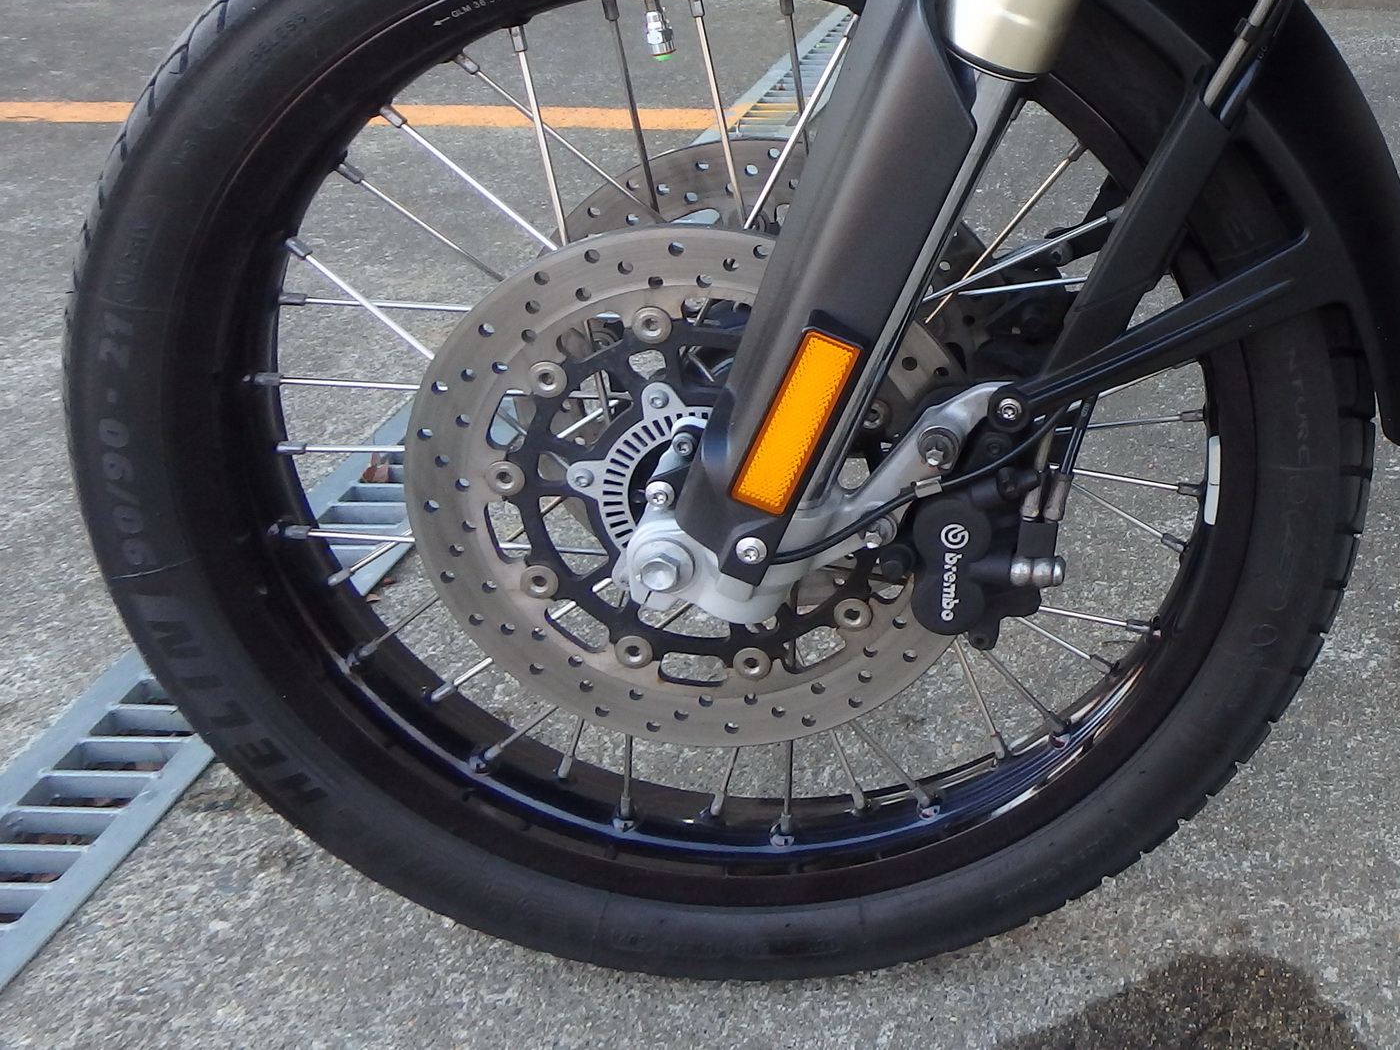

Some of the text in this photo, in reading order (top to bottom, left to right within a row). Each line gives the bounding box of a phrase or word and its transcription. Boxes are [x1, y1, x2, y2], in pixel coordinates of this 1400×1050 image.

[451, 4, 472, 19] GLM
[99, 310, 134, 371] 21
[98, 417, 158, 567] 90/90
[941, 553, 963, 621] brembo
